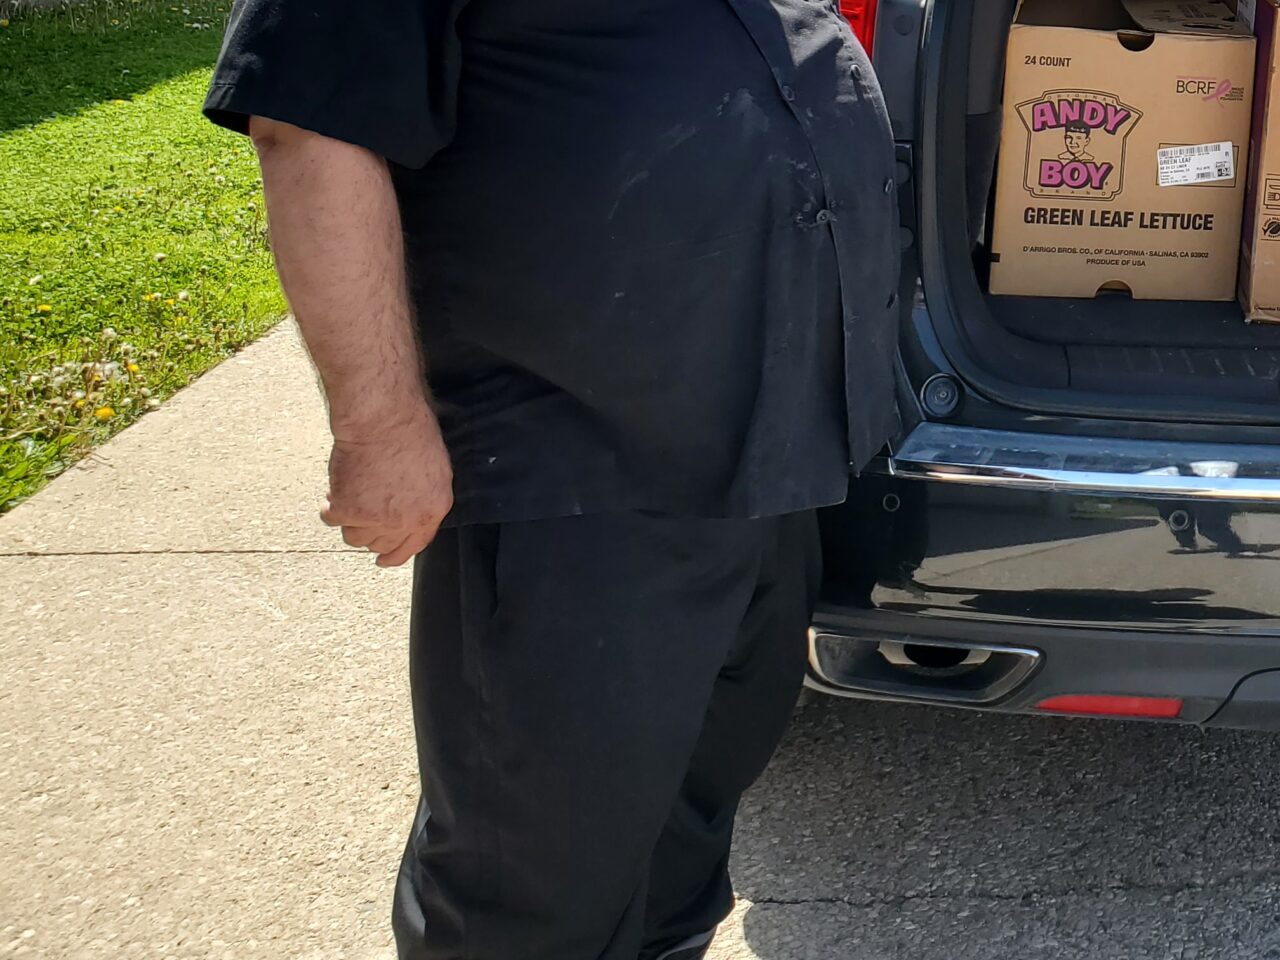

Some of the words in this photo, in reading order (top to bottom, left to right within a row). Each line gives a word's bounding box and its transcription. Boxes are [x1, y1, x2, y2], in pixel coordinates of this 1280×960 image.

[1024, 55, 1037, 65] 24
[1039, 55, 1072, 68] COUNT
[1176, 79, 1217, 95] BCRF
[1032, 98, 1132, 136] ANDY
[1039, 158, 1114, 190] BOY
[1023, 207, 1084, 226] GREEN
[1089, 209, 1134, 228] LEAF
[1139, 212, 1215, 231] LETTUCE
[1104, 248, 1145, 257] CALIFORNIA
[1149, 250, 1179, 259] SALINAS,
[1086, 258, 1120, 266] PRODUCE
